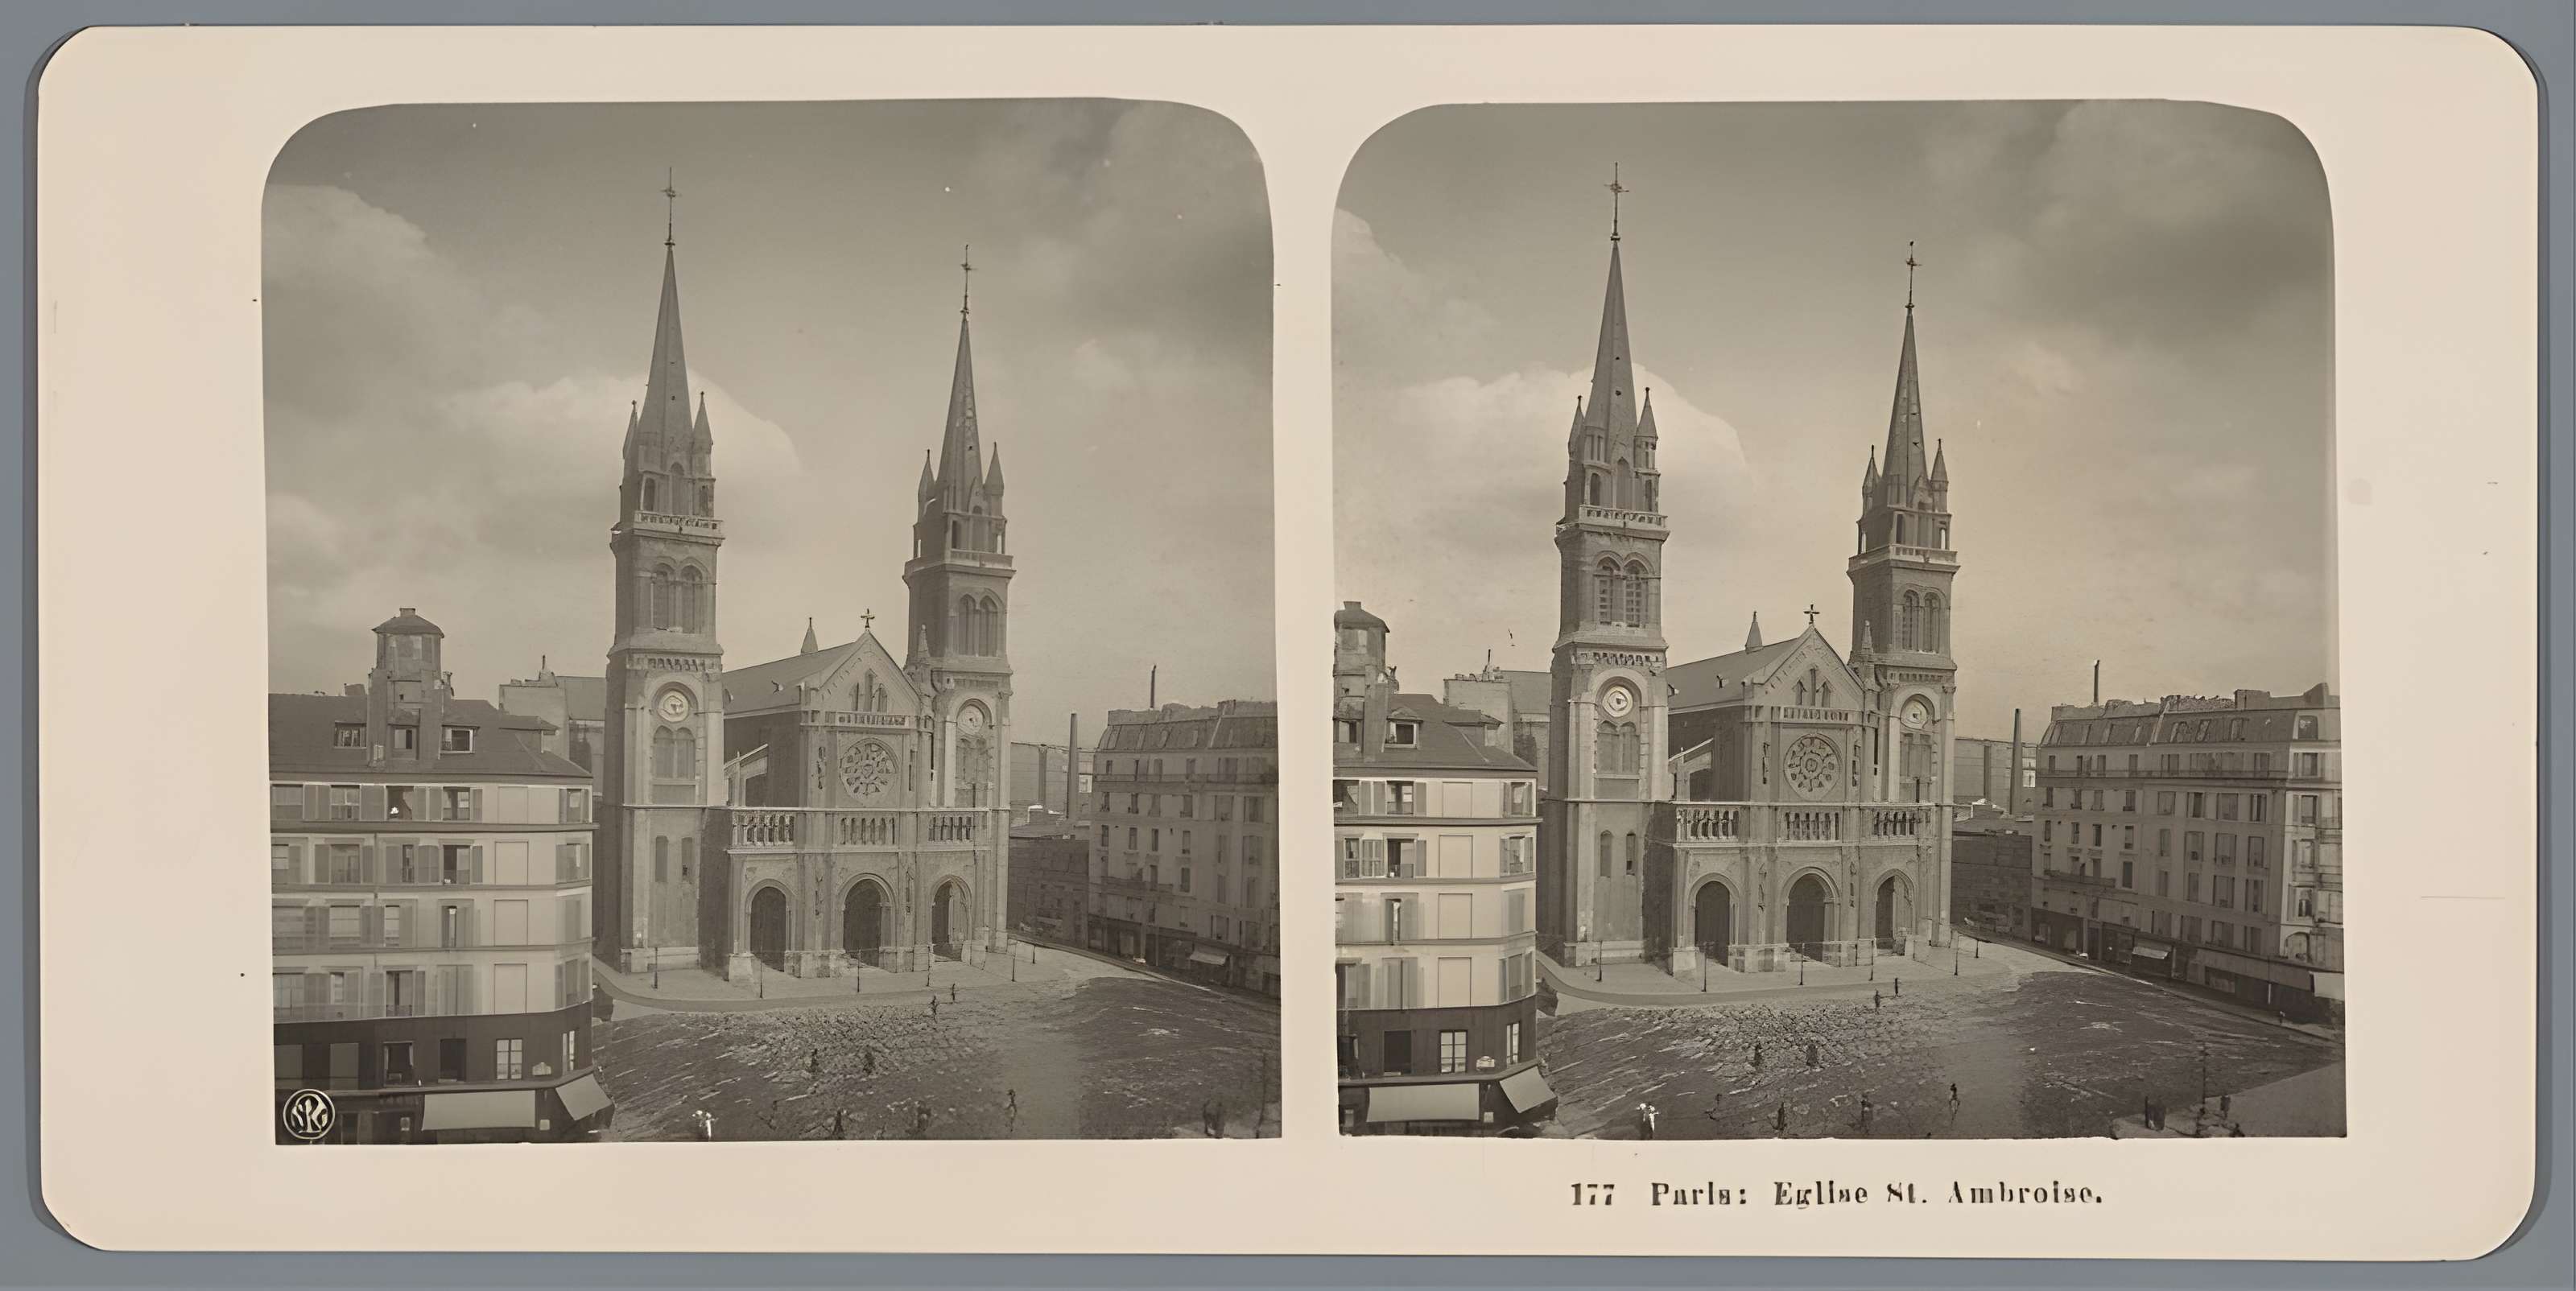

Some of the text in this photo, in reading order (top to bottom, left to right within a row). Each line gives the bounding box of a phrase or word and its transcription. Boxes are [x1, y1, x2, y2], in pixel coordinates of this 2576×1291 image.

[1571, 1180, 2103, 1209] 177 Paris: Eglise St. Ambroise.
